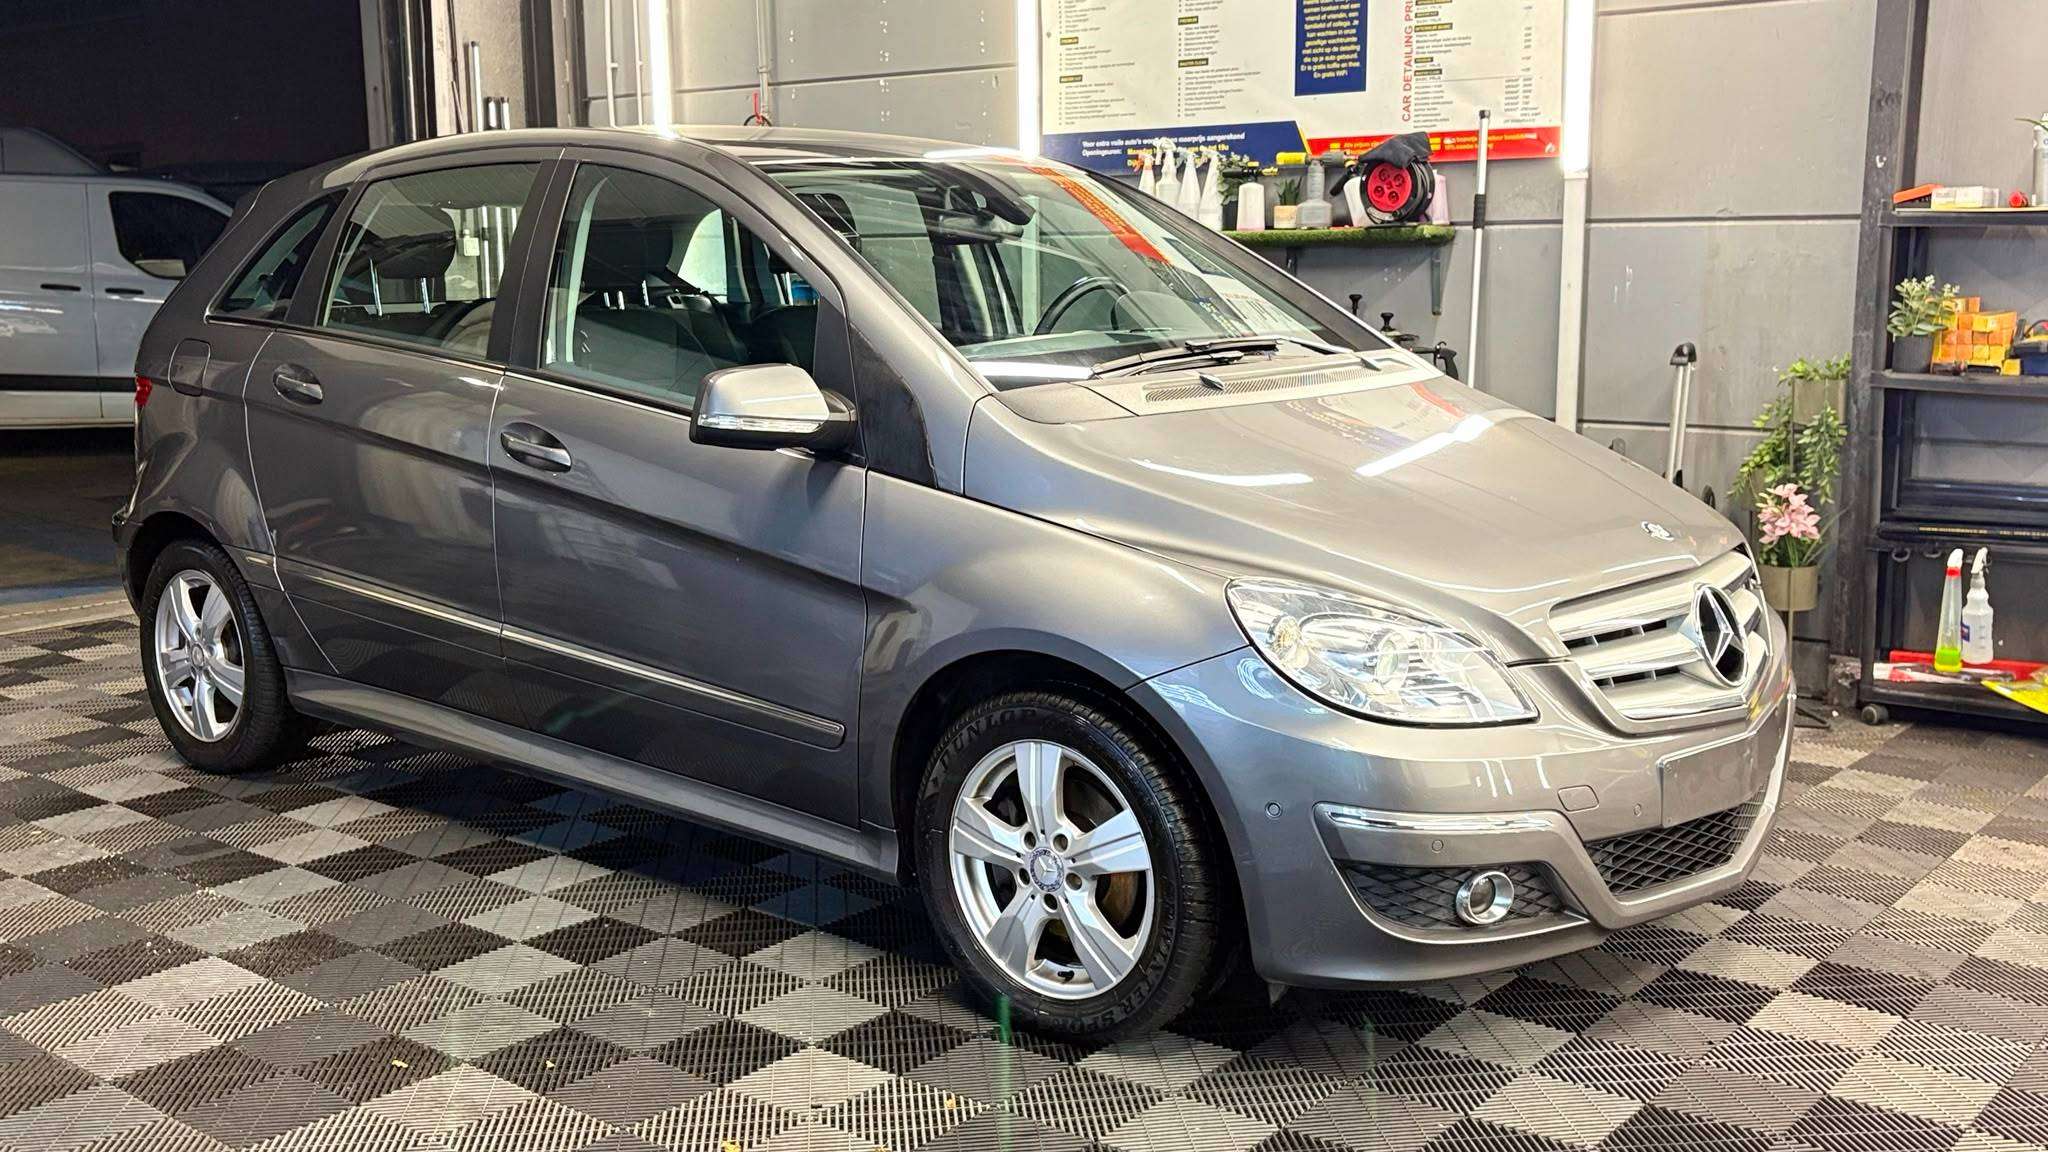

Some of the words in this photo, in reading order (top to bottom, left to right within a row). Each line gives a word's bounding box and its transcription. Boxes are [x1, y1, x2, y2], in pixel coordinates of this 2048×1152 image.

[1313, 63, 1326, 71] gratis
[1403, 25, 1414, 91] DETAILING
[1322, 71, 1335, 79] gratis
[1402, 95, 1411, 122] CAR
[1179, 135, 1206, 144] meerprijs
[1207, 132, 1245, 142] aangerekend
[939, 709, 1037, 771] DUNLOP
